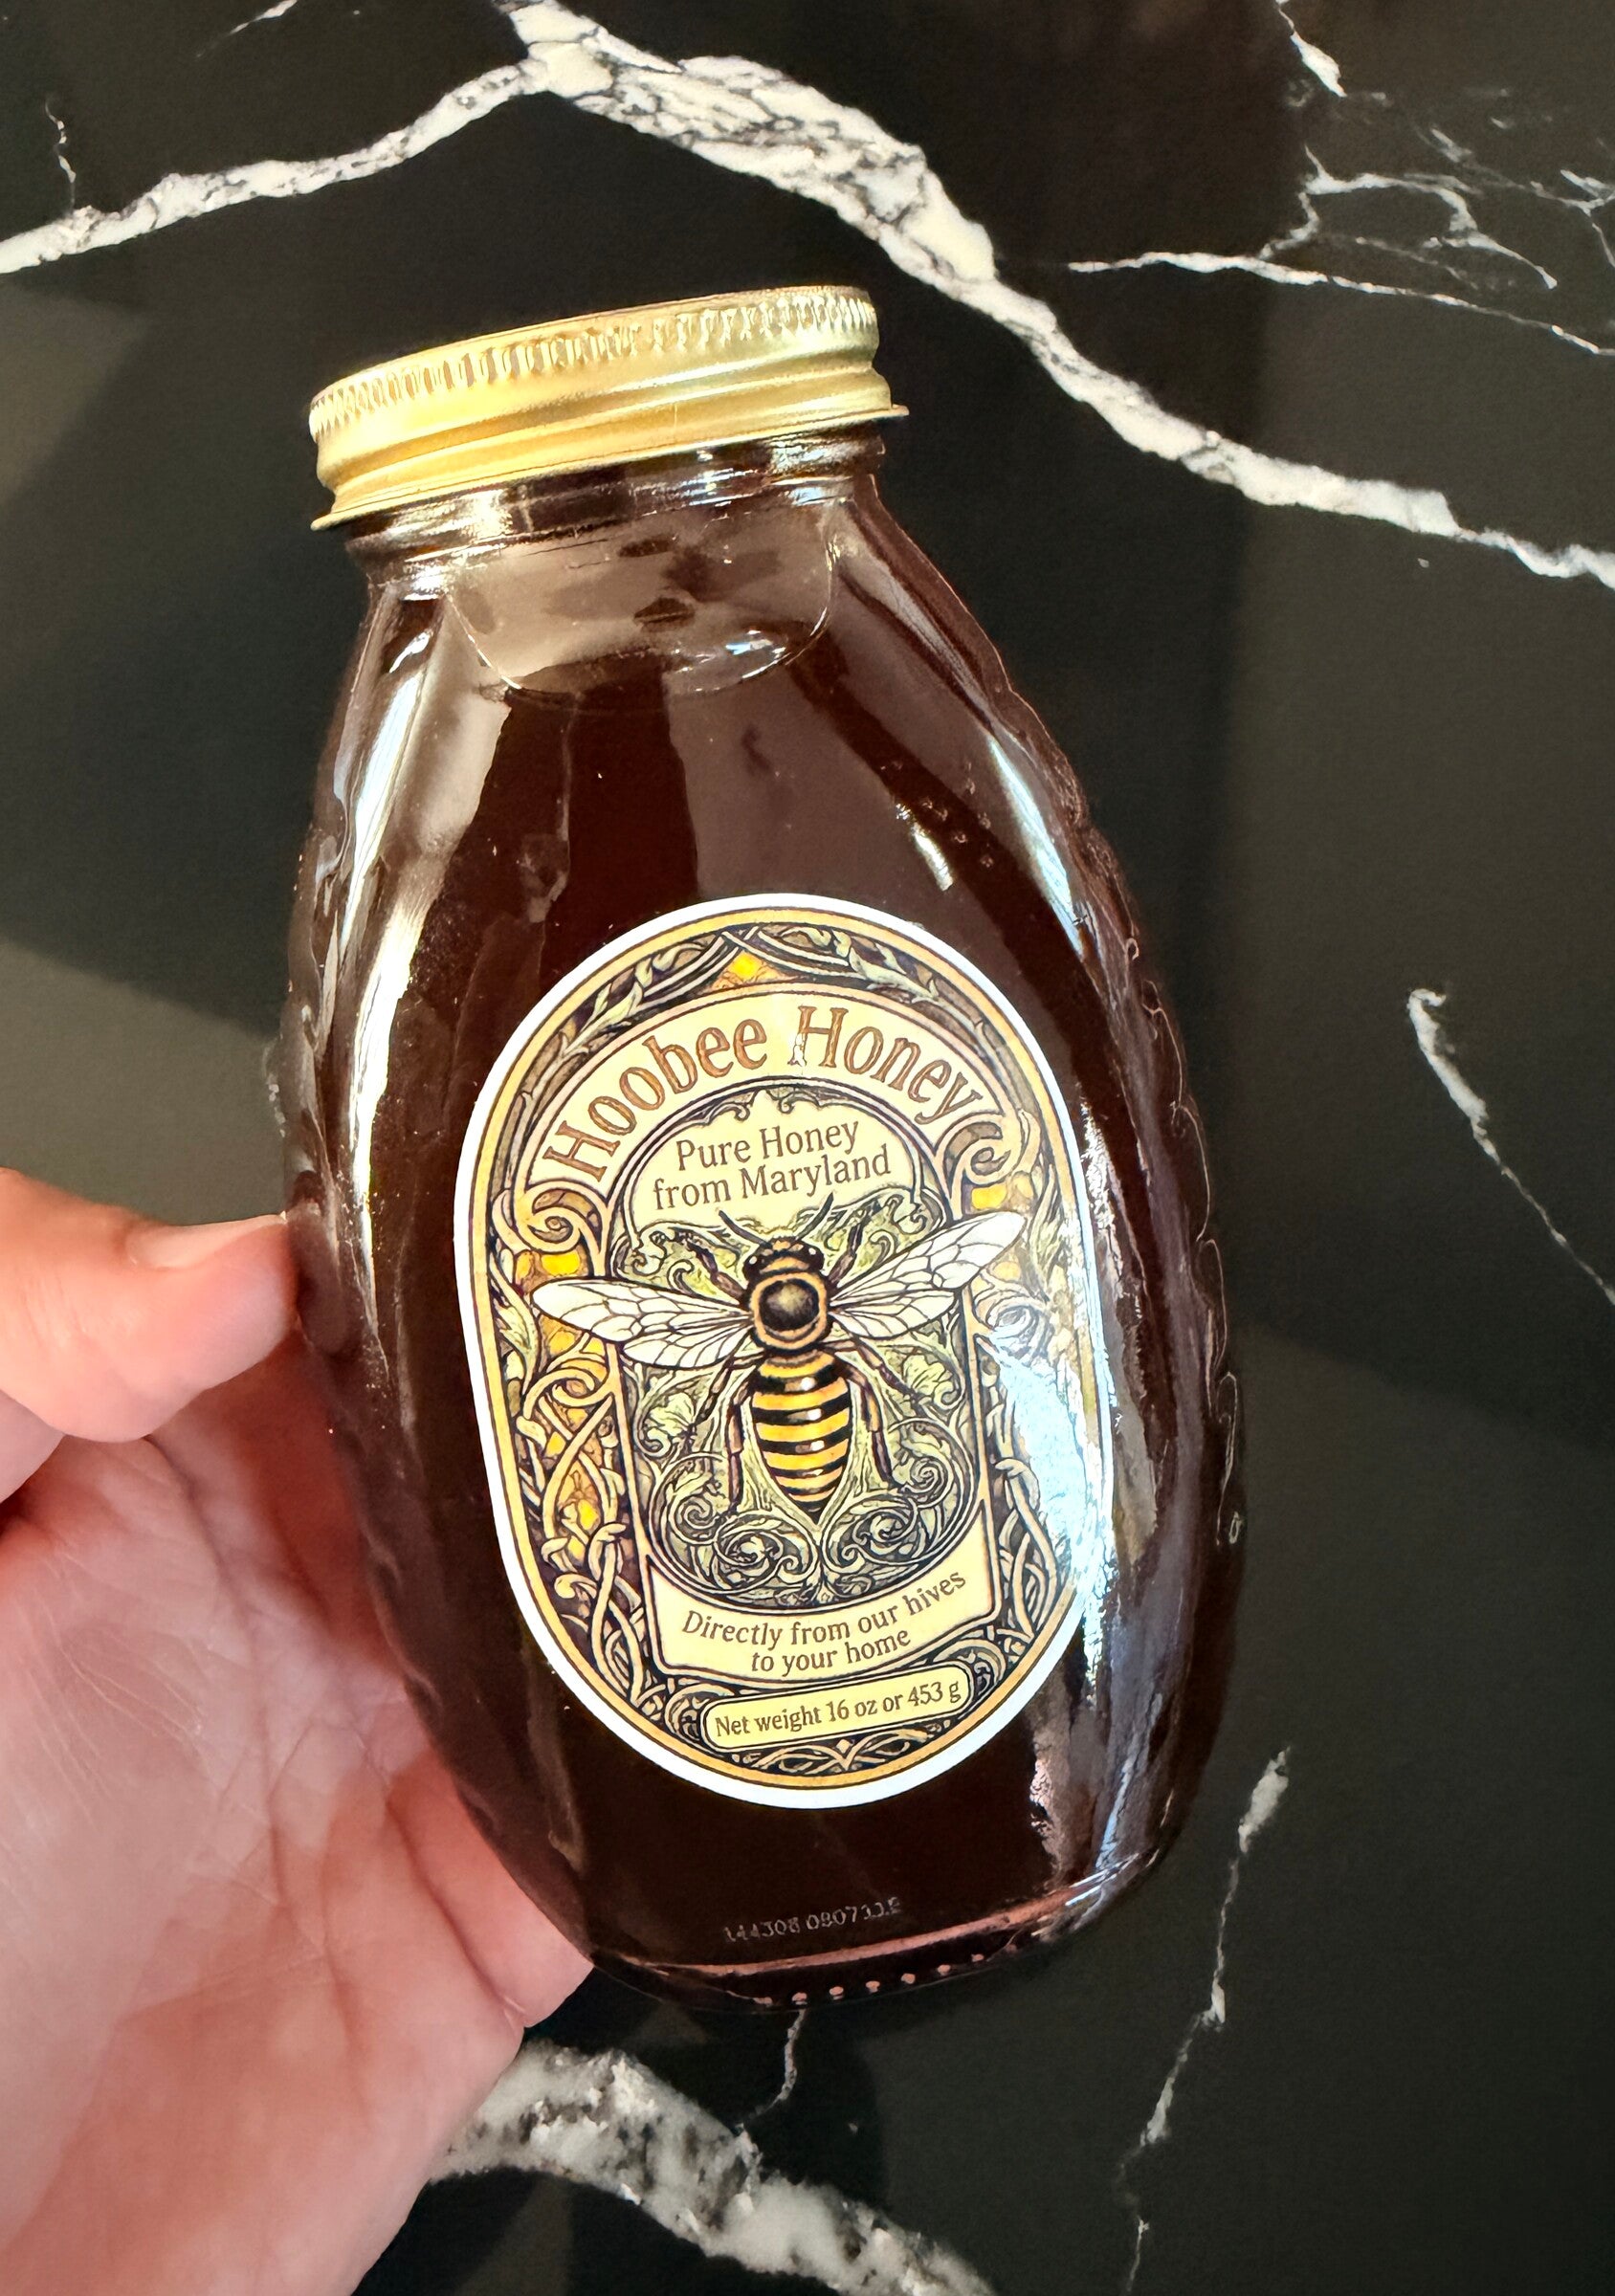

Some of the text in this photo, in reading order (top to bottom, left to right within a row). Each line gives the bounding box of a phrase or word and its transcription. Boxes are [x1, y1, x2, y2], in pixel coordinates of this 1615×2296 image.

[542, 1004, 984, 1182] Hoobee Honey
[675, 1119, 859, 1172] Pure Honey
[653, 1144, 892, 1211] from Maryland
[682, 1570, 967, 1651] Directly from our hives
[751, 1628, 912, 1678] to your home
[715, 1681, 962, 1737] Net weight 16 oz or 453 g
